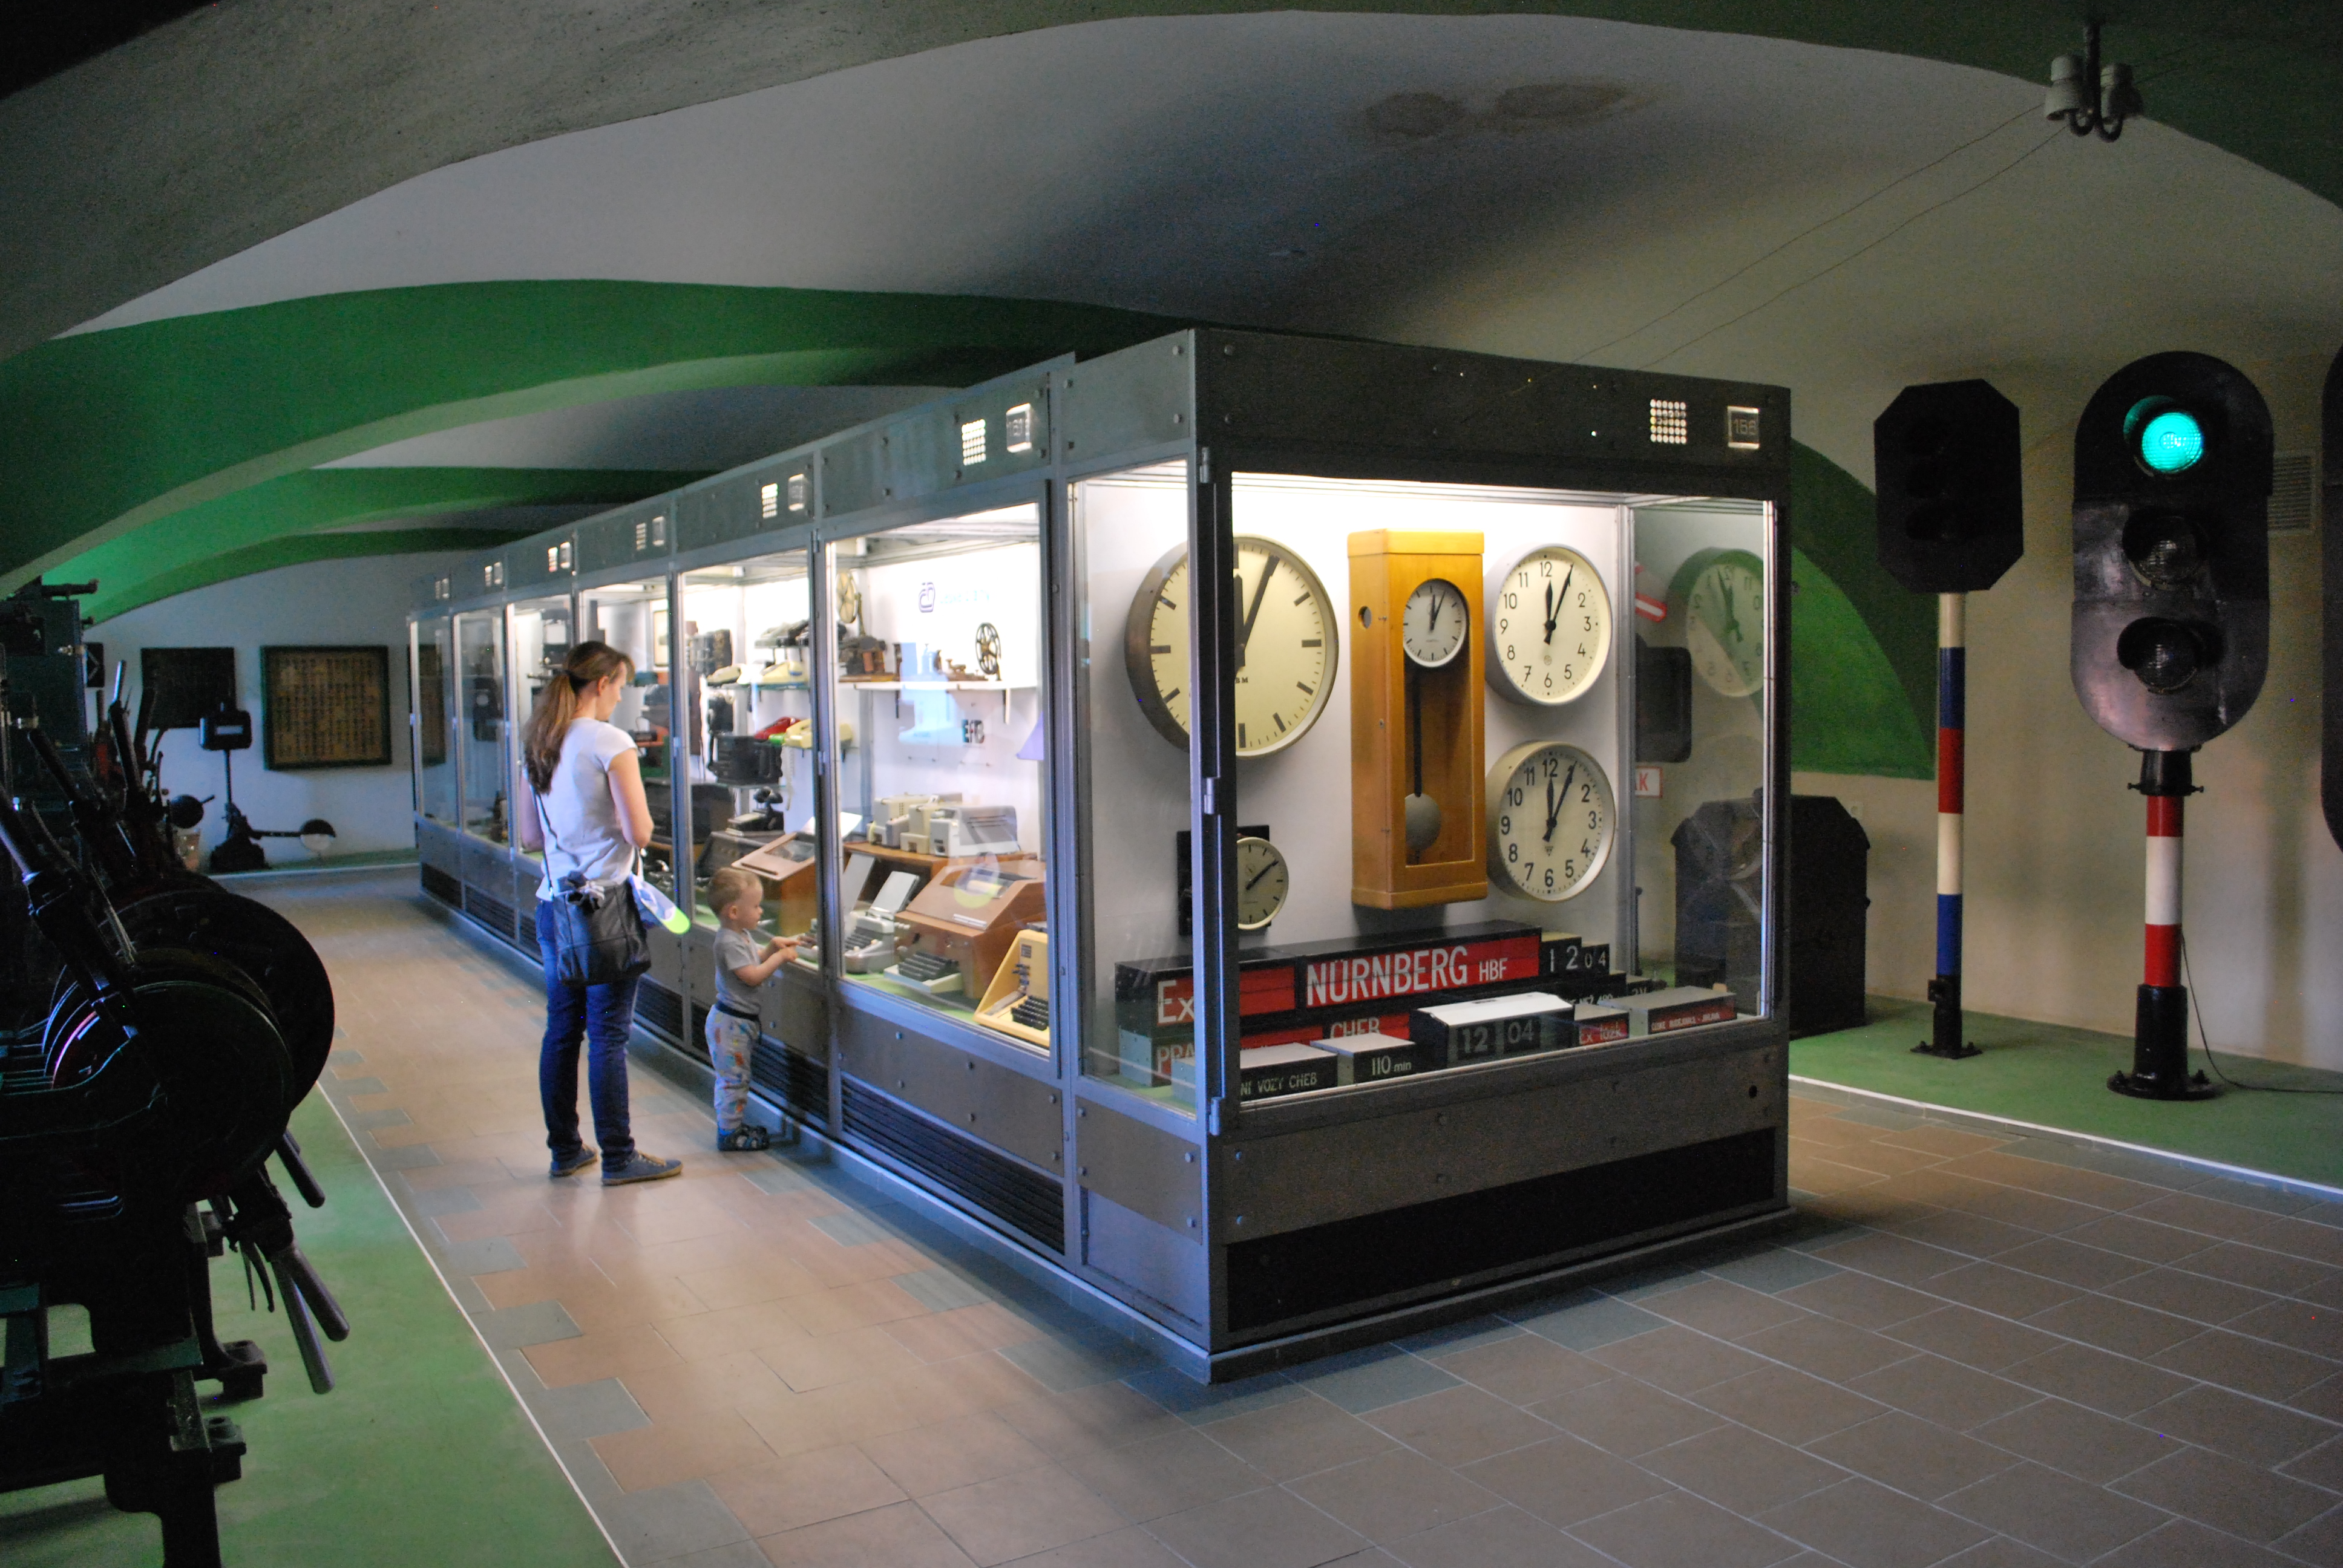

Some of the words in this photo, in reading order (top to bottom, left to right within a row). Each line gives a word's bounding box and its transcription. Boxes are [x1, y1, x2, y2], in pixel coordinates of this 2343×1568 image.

[1540, 561, 1552, 577] 12
[1519, 572, 1528, 587] 11
[1504, 593, 1517, 609] 10
[1578, 593, 1585, 607] 2
[1500, 619, 1508, 634] 9
[1584, 616, 1591, 632] 3
[1507, 645, 1515, 660] 8
[1578, 642, 1585, 657] 4
[1524, 666, 1531, 682] 7
[1544, 673, 1552, 688] 6
[1564, 664, 1571, 679] 5
[1524, 766, 1535, 786] 11
[1542, 759, 1558, 777] 12
[1508, 788, 1522, 806] 10
[1582, 784, 1590, 803] 2
[1501, 816, 1510, 835] 9
[1588, 811, 1596, 829] 3
[1509, 843, 1518, 863] 8
[1581, 838, 1590, 858] 4
[1525, 863, 1534, 881] 7
[1545, 869, 1553, 887] 6
[1565, 860, 1573, 878] 5
[1306, 946, 1468, 1006] NÜRNBERG
[1478, 958, 1509, 982] HBF
[1462, 1026, 1488, 1054] 12
[1507, 1019, 1535, 1044] 04
[1371, 1055, 1392, 1076] 110
[1394, 1060, 1412, 1073] min
[1257, 1076, 1284, 1093] VOZY
[1289, 1072, 1318, 1088] CHEB
